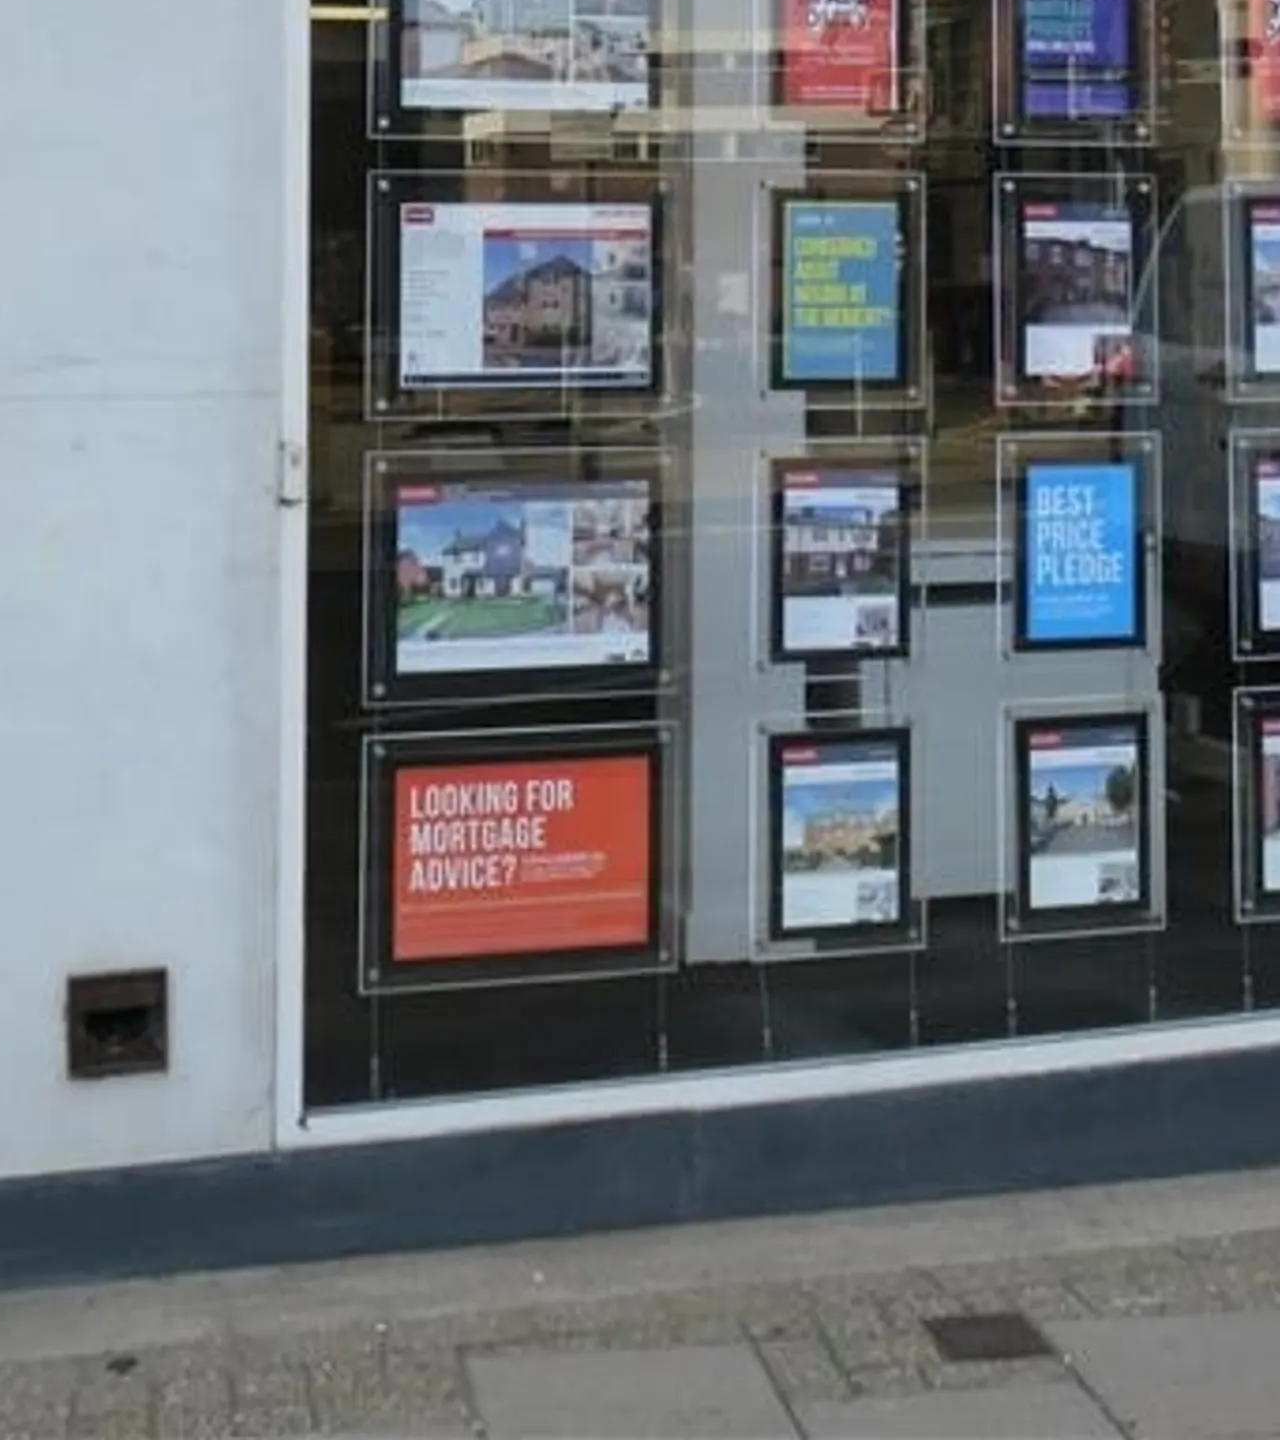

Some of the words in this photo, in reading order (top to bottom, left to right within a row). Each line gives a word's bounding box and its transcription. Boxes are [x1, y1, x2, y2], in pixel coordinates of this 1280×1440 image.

[1036, 483, 1095, 517] BEST
[1036, 519, 1106, 550] PRICE
[1036, 552, 1124, 587] PLEDGE
[410, 779, 518, 819] LOOKING
[526, 777, 574, 812] FOR
[410, 816, 547, 855] MORTGAGE
[410, 854, 518, 893] ADVICE?
